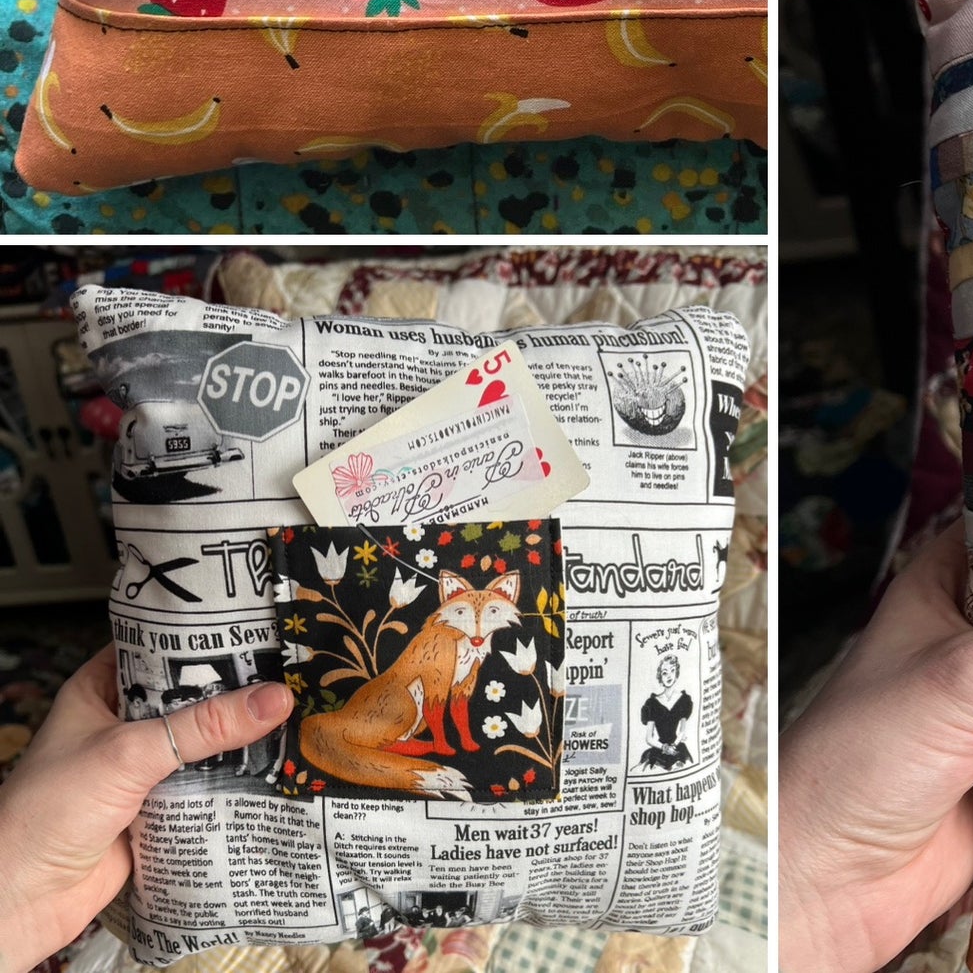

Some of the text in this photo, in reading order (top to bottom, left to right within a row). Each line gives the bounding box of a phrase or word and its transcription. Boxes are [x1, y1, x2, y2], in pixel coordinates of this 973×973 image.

[103, 319, 147, 340] that border!
[203, 322, 235, 332] sanity!
[315, 321, 384, 338] Woman
[388, 330, 426, 344] uses
[527, 333, 590, 347] human
[592, 325, 689, 352] pincushion!
[359, 351, 396, 361] needling
[483, 350, 511, 375] 5
[319, 370, 344, 379] walks
[347, 371, 386, 379] barefoot
[399, 372, 413, 382] the
[355, 361, 404, 370] understand
[407, 365, 427, 375] what
[430, 367, 442, 375] his
[206, 364, 301, 412] STOP
[319, 382, 398, 392] pins and needles.
[575, 438, 600, 446] thinks
[628, 451, 688, 462] Jack Ripper (above)
[625, 461, 689, 471] claims his wife forces
[348, 440, 524, 523] Panic in Polkadots
[653, 482, 679, 490] needles!
[569, 610, 608, 621] of truth!
[114, 618, 145, 648] think
[149, 630, 182, 654] you
[188, 630, 224, 651] can
[566, 628, 614, 655] Report
[589, 767, 607, 776] Sally
[632, 773, 717, 805] What happens
[563, 793, 588, 803] perfect
[226, 798, 308, 816] is allowed by phone.
[331, 800, 349, 810] hard
[361, 803, 380, 812] Keep
[382, 804, 404, 813] things
[524, 807, 539, 816] stay
[541, 806, 548, 814] in
[550, 805, 562, 813] and
[234, 810, 320, 829] Rumor has it that the
[630, 807, 665, 829] shop
[454, 818, 599, 841] Men wait 37 years!
[430, 835, 618, 860] Ladies have not surfaced!
[153, 930, 182, 955] The
